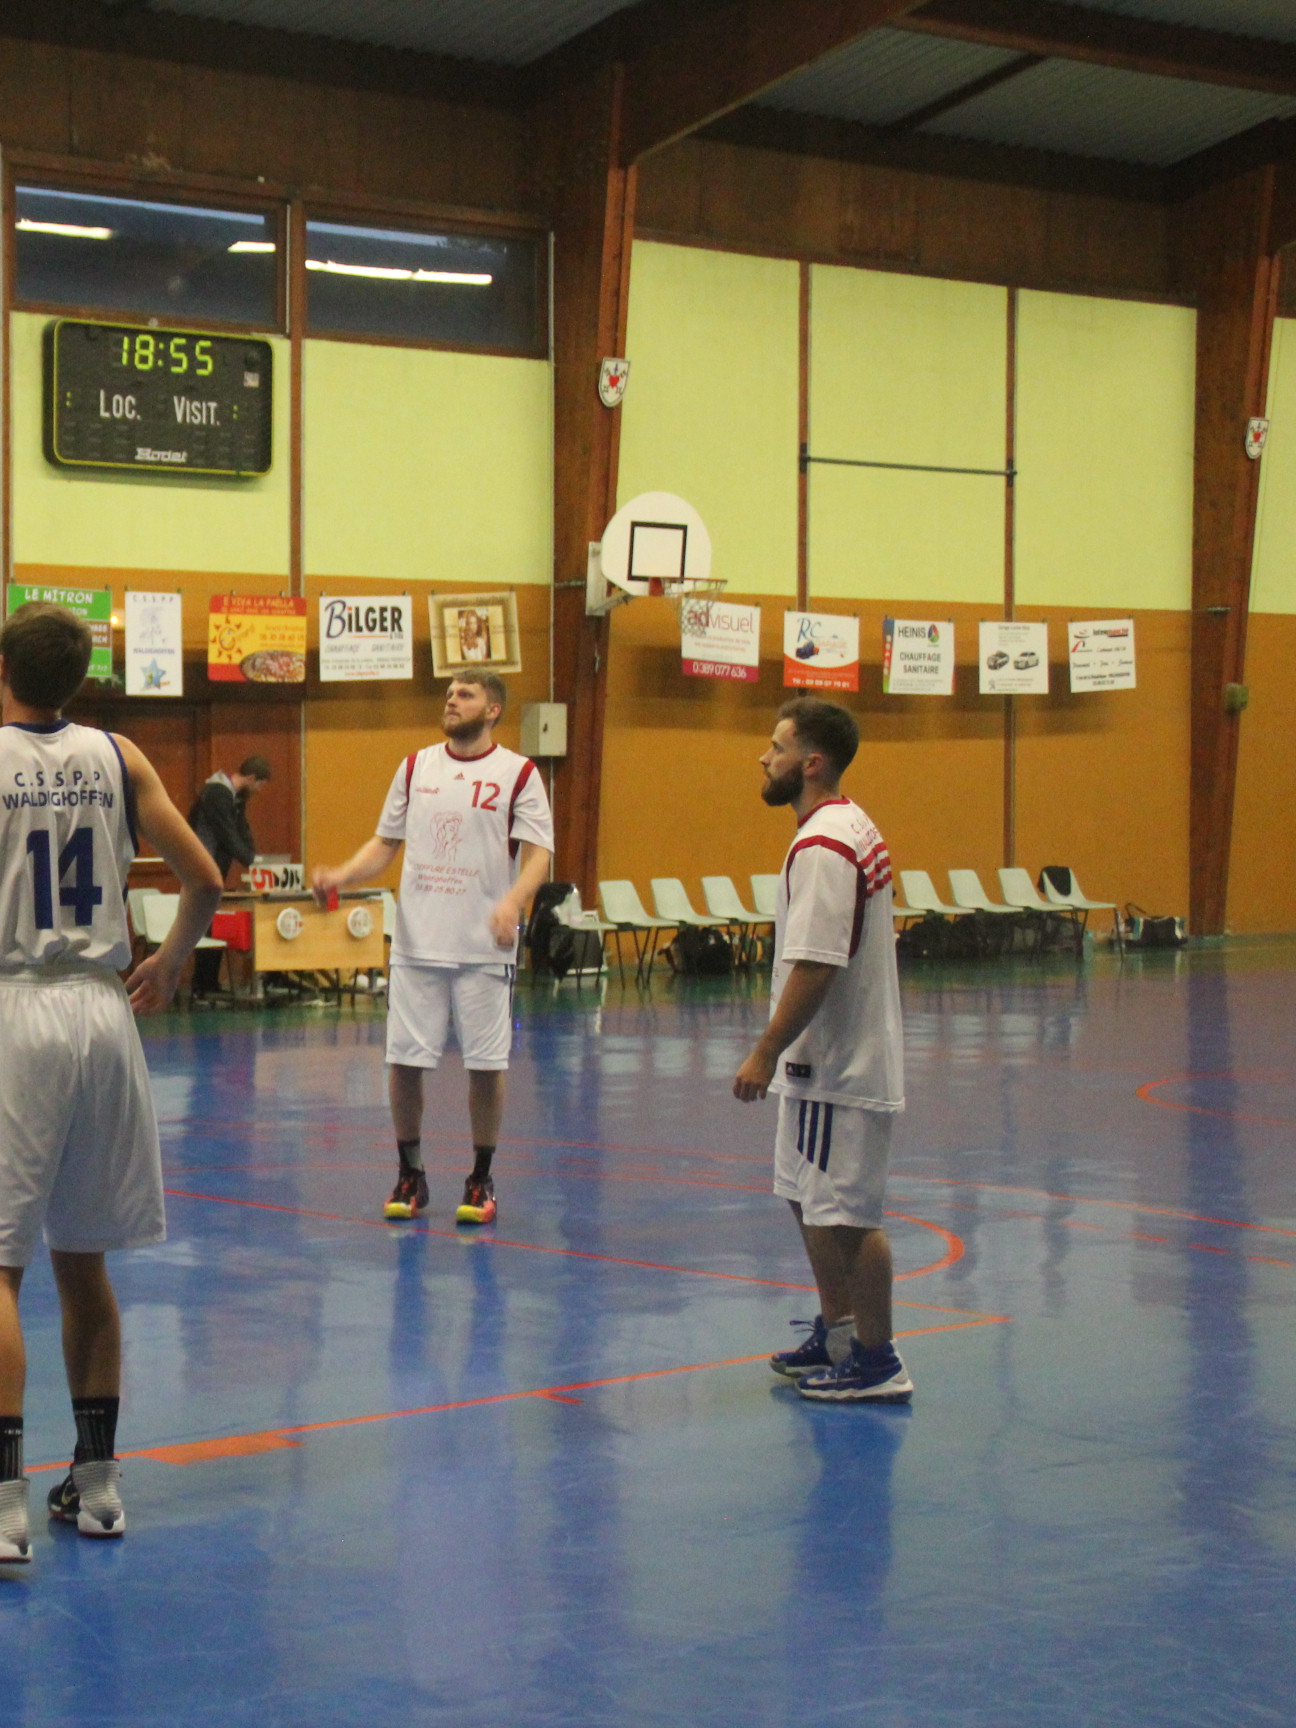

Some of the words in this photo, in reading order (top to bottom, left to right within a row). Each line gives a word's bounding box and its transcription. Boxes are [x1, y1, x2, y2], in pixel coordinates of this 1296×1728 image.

[120, 334, 214, 376] 18:55
[24, 587, 39, 601] LE
[43, 589, 93, 604] MITRON
[687, 605, 755, 633] advisuel
[897, 625, 926, 639] HEINIS
[899, 650, 942, 663] CHAUFFAGE
[902, 664, 940, 675] SANITAIRE
[471, 780, 501, 812] 12
[26, 826, 103, 930] 14
